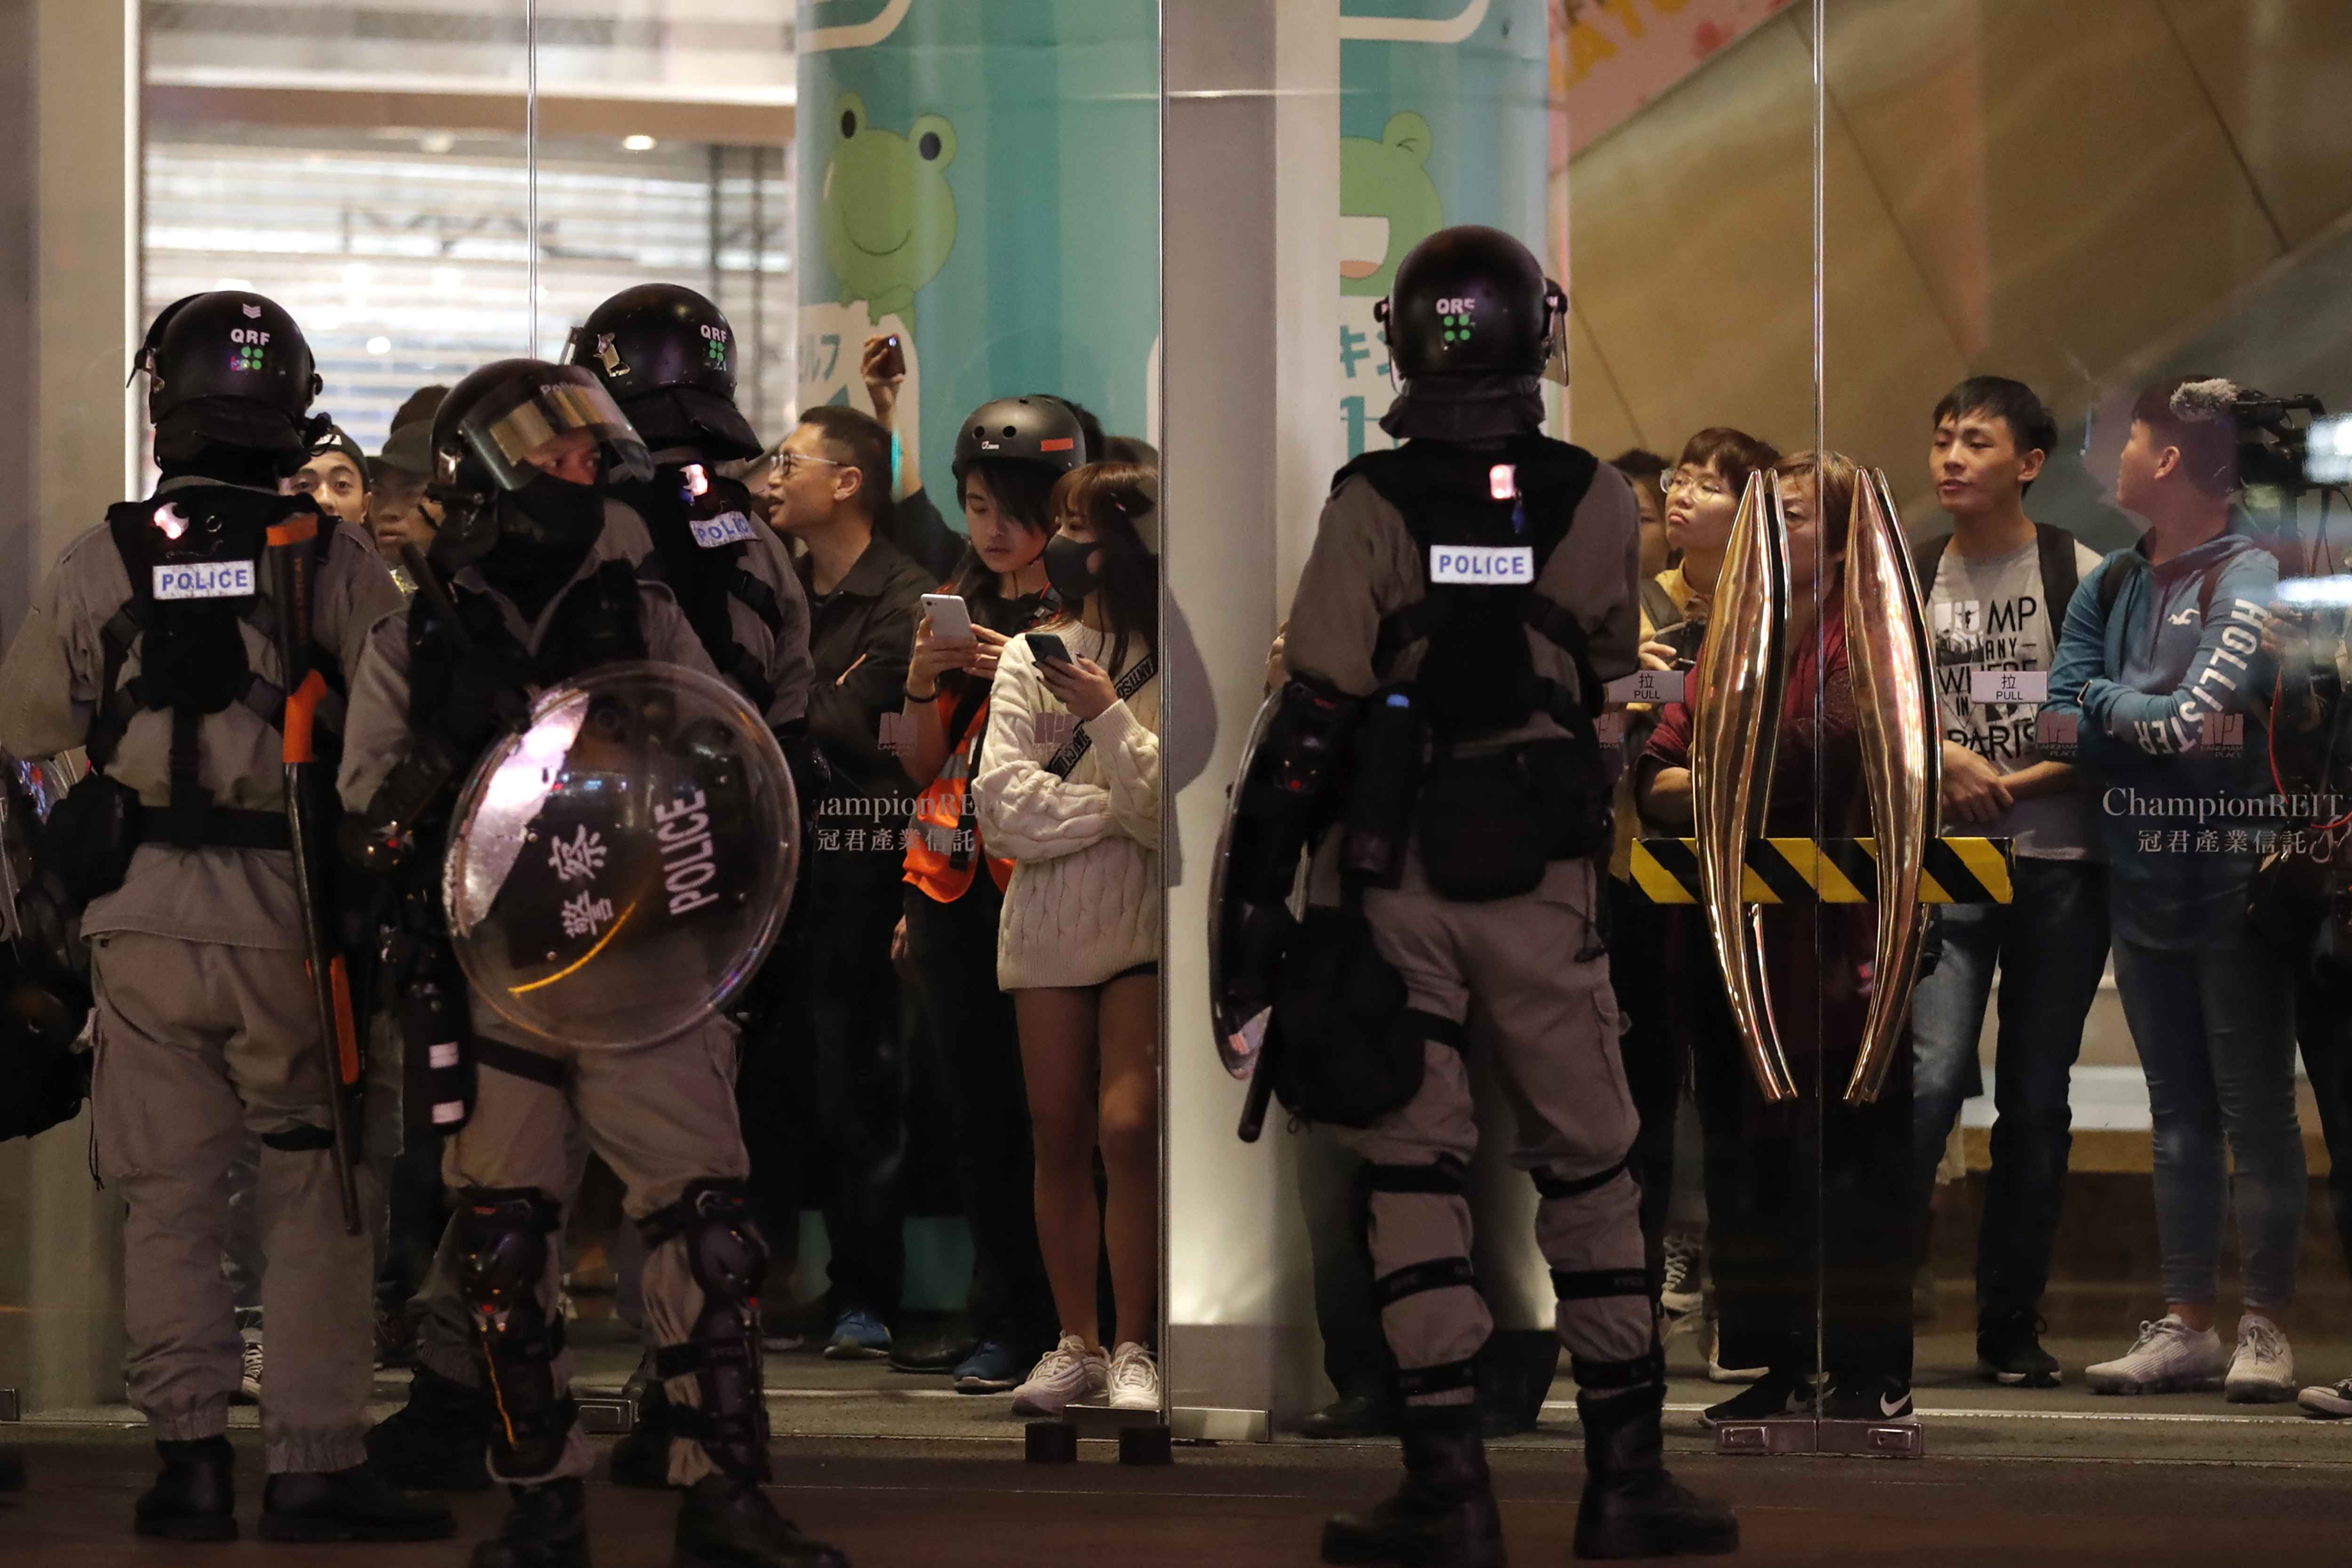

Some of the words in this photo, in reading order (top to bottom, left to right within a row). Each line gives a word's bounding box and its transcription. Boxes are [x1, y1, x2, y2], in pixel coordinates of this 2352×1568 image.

[230, 328, 270, 346] QRF
[700, 325, 726, 342] QRF
[697, 518, 755, 541] POLIC
[1439, 555, 1524, 574] POLICE
[162, 570, 248, 591] POLICE
[1639, 673, 1653, 688] 拉
[2002, 674, 2016, 689] 拉
[2134, 598, 2269, 755] HOLLISTER
[1634, 690, 1661, 699] PULL
[1996, 691, 2023, 700] PULL
[1956, 696, 1969, 716] IN
[2102, 788, 2343, 824] ChampionREIT
[2138, 829, 2306, 854] 冠君產業信託
[653, 789, 719, 915] POLICE
[548, 824, 613, 938] 警察
